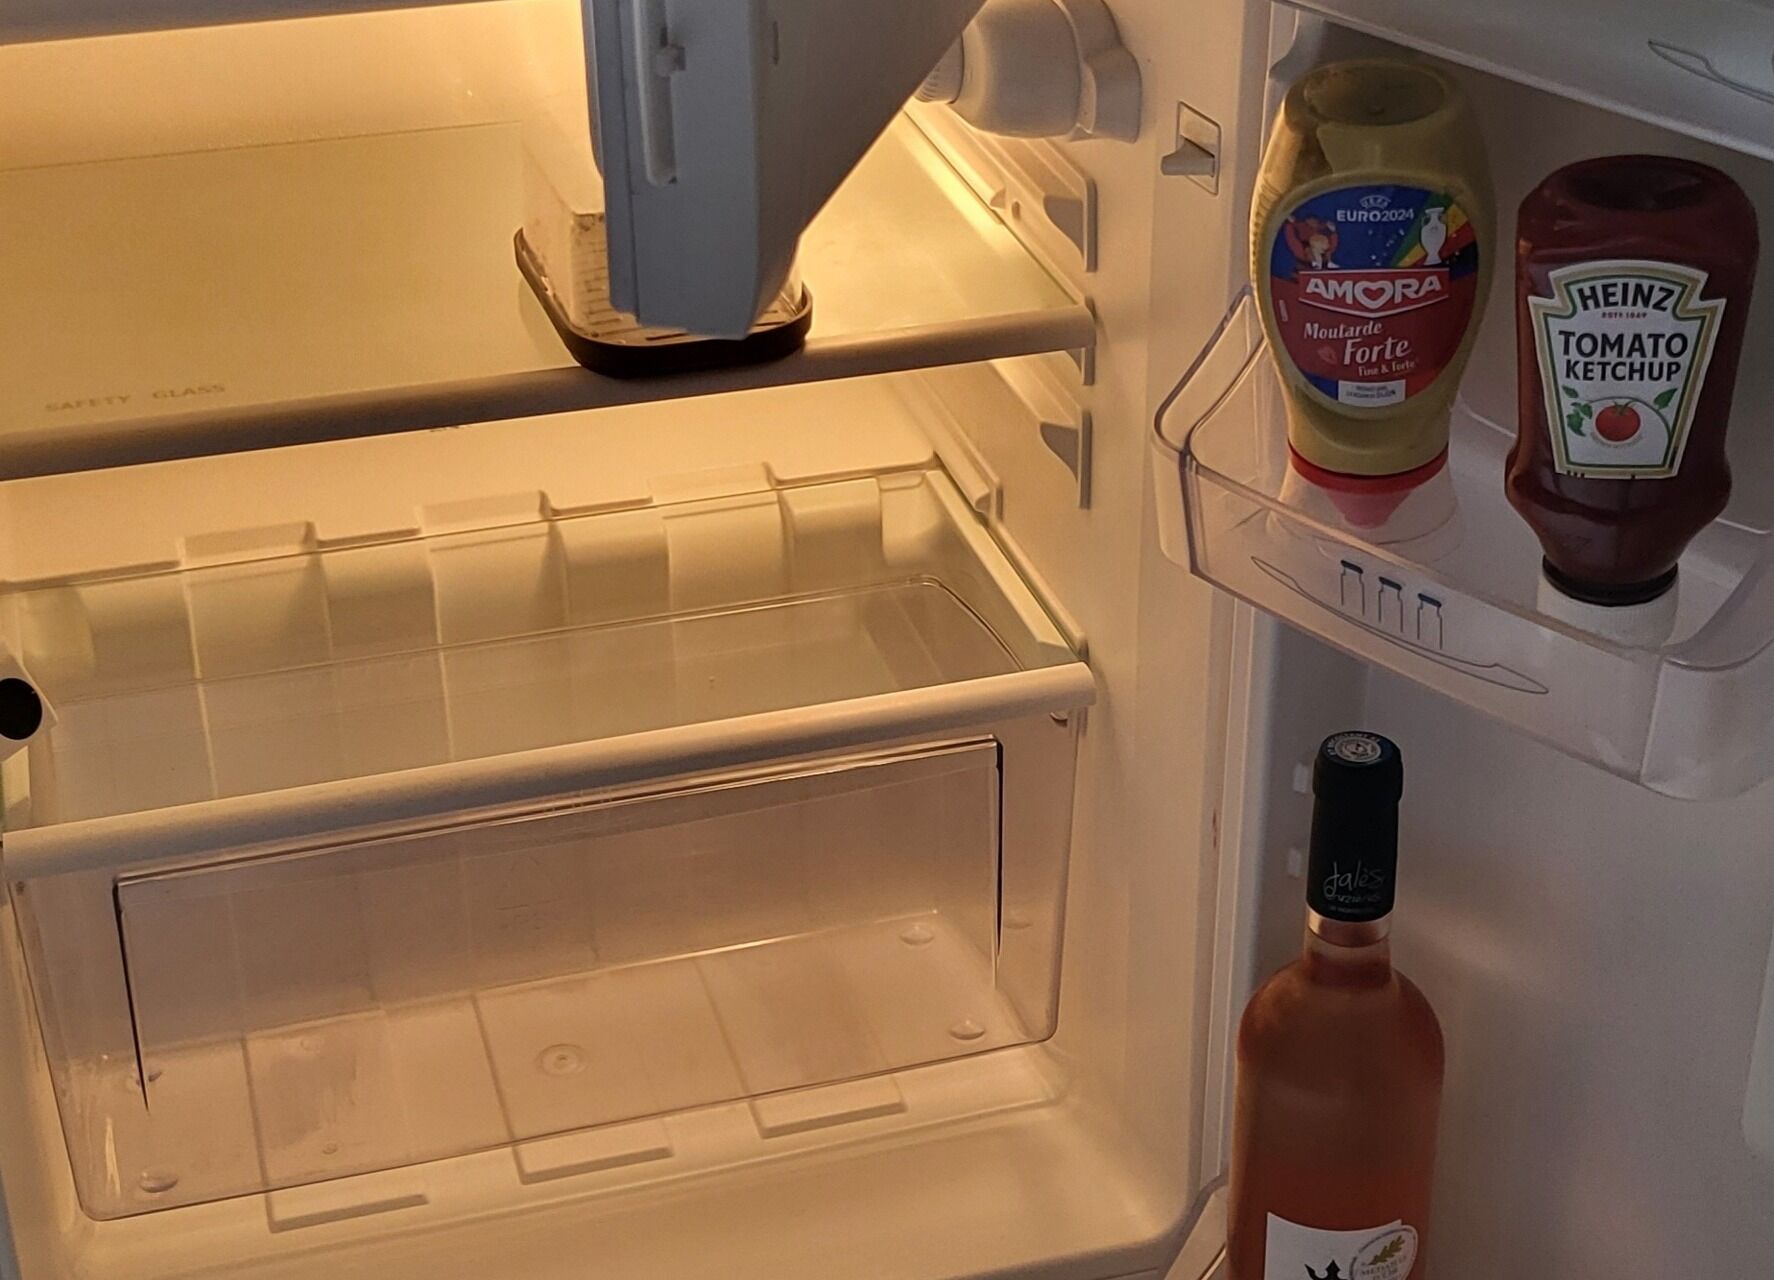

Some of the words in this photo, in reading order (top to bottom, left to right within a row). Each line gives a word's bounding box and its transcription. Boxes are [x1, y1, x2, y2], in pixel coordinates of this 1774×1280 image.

[1305, 275, 1443, 310] AMORA
[1577, 282, 1675, 311] HEINZ
[1303, 320, 1383, 340] Moutarde
[1558, 330, 1689, 358] TOMATO
[1343, 336, 1412, 366] Forte
[1565, 359, 1682, 382] KETCHUP
[45, 394, 131, 412] SAFETY
[152, 384, 226, 400] GLASS
